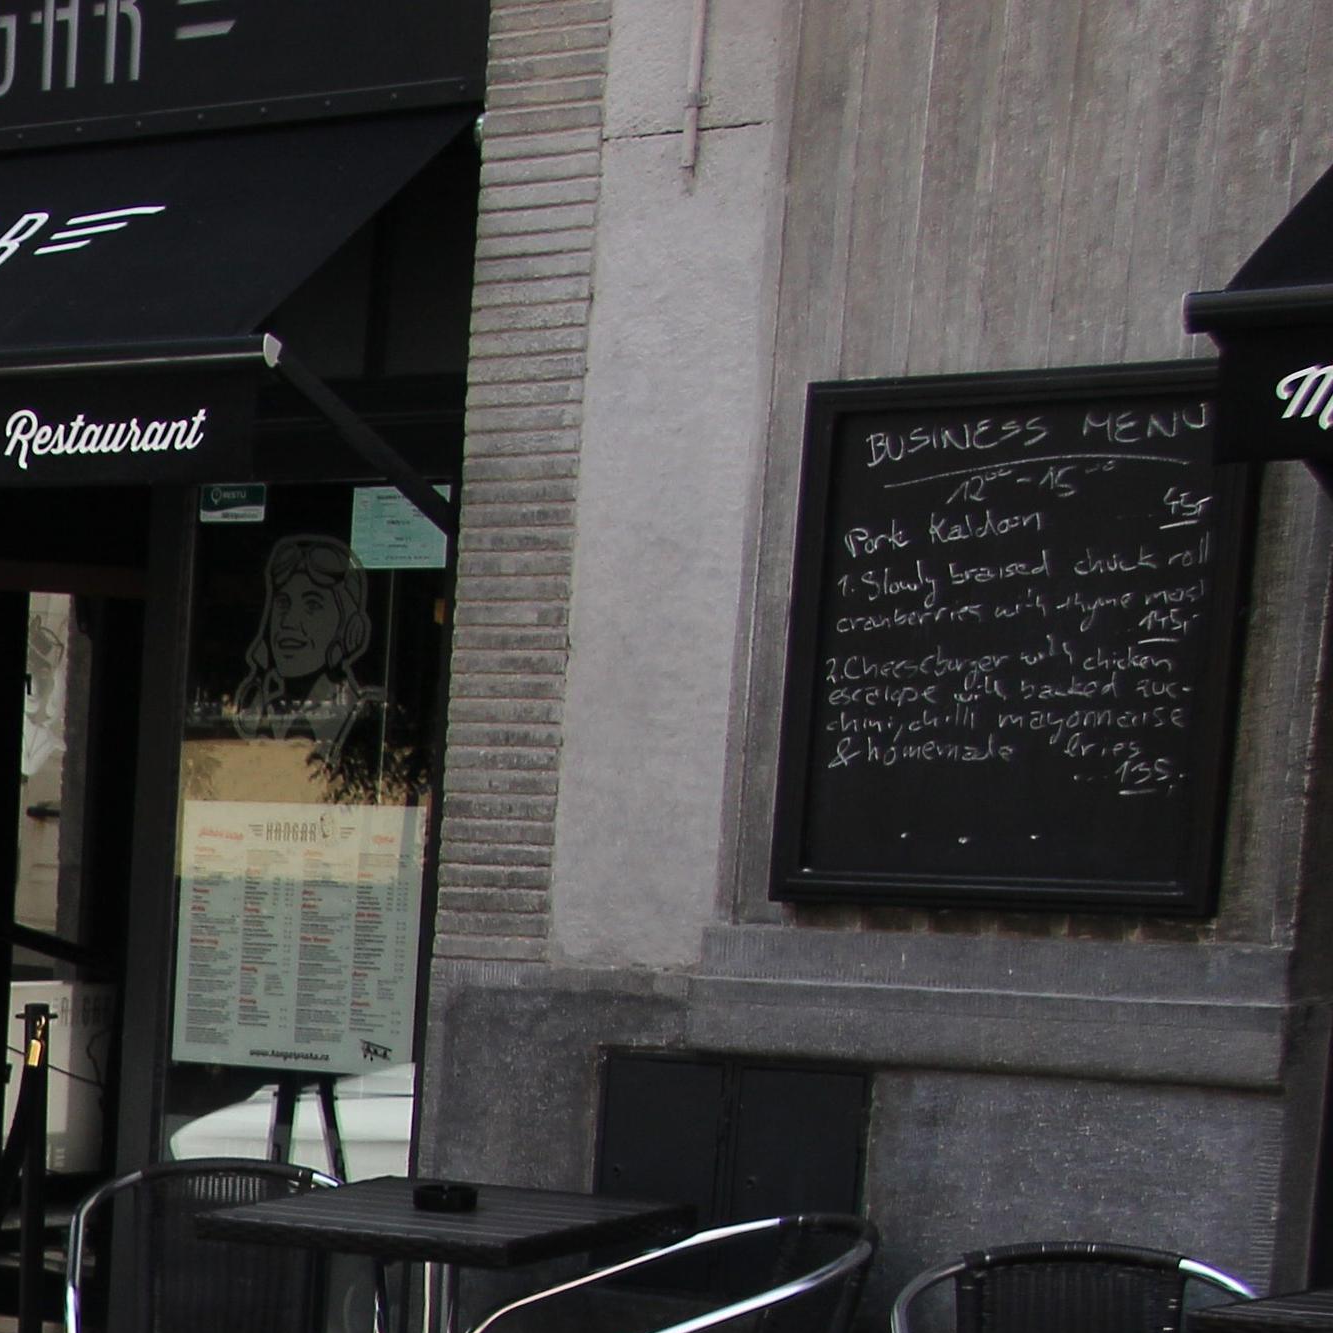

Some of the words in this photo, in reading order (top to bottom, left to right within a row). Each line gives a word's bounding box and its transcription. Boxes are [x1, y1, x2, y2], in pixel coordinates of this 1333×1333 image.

[3, 408, 206, 470] Restaurant
[866, 416, 1050, 467] BUSINESS
[1082, 402, 1208, 443] MENU
[843, 519, 910, 558] Pork
[949, 549, 1051, 585] braised
[1074, 545, 1158, 575] chuck
[1168, 531, 1211, 567] roll
[836, 599, 983, 633] cranberries
[995, 587, 1047, 619] with
[1082, 647, 1172, 672] chicken
[828, 681, 941, 707] escalope
[998, 707, 1185, 745] mayonnaise
[266, 821, 317, 842] HANGAR
